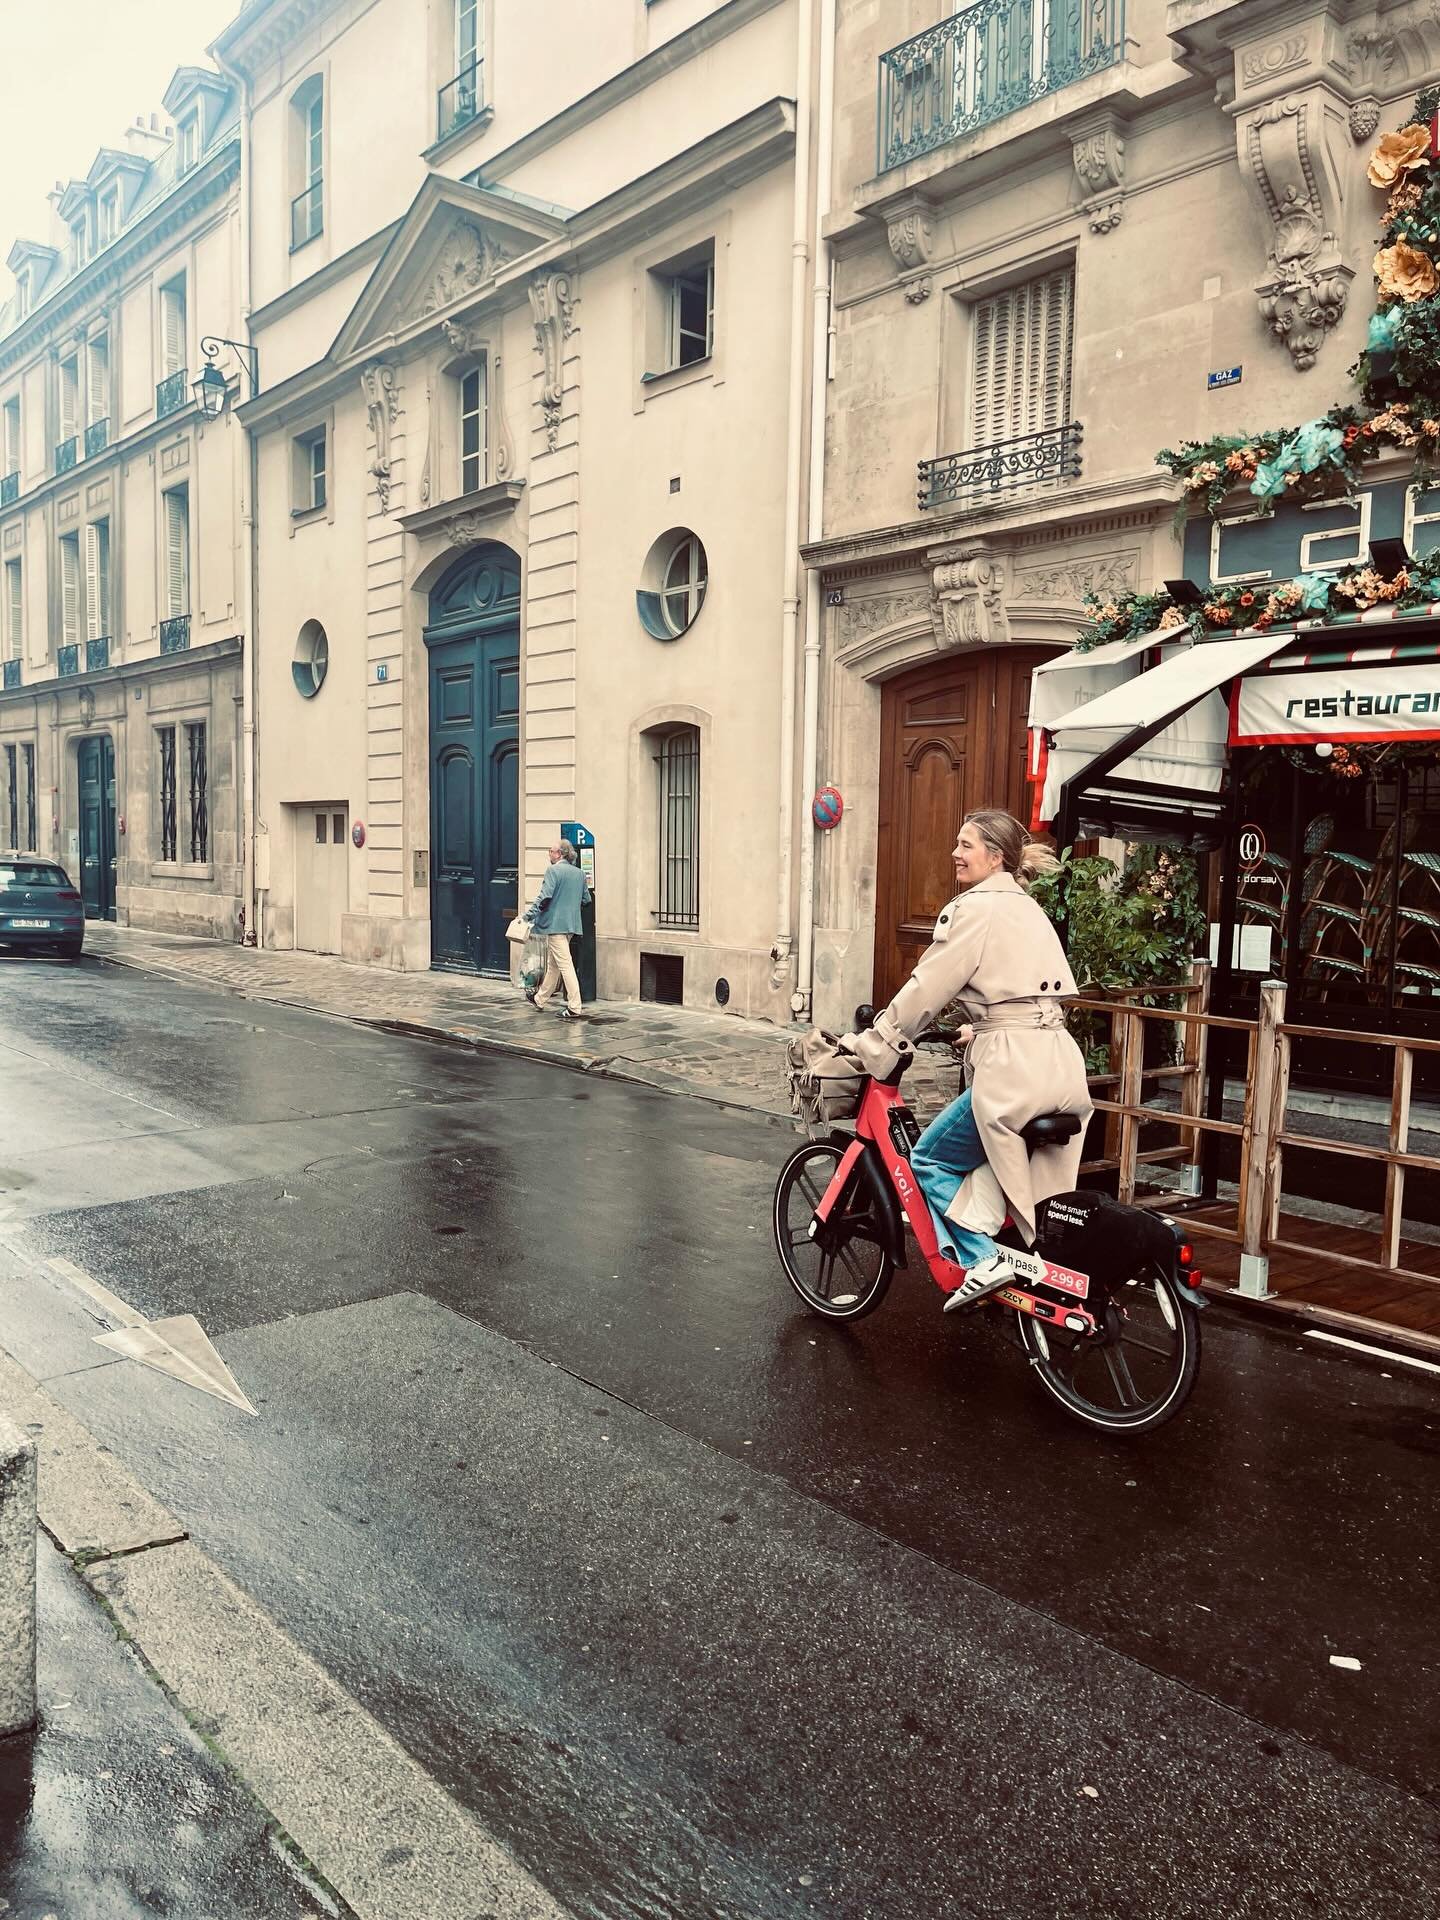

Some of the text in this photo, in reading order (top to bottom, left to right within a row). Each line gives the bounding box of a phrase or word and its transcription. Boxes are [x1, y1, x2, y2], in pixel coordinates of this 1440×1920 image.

[1215, 369, 1233, 381] GAZ
[377, 666, 386, 679] 71
[894, 1165, 914, 1203] voi.
[1049, 1199, 1067, 1211] Move
[1047, 1210, 1085, 1226] spend less.
[1007, 1253, 1014, 1265] h
[1015, 1258, 1038, 1276] pass
[1074, 1279, 1085, 1291] €
